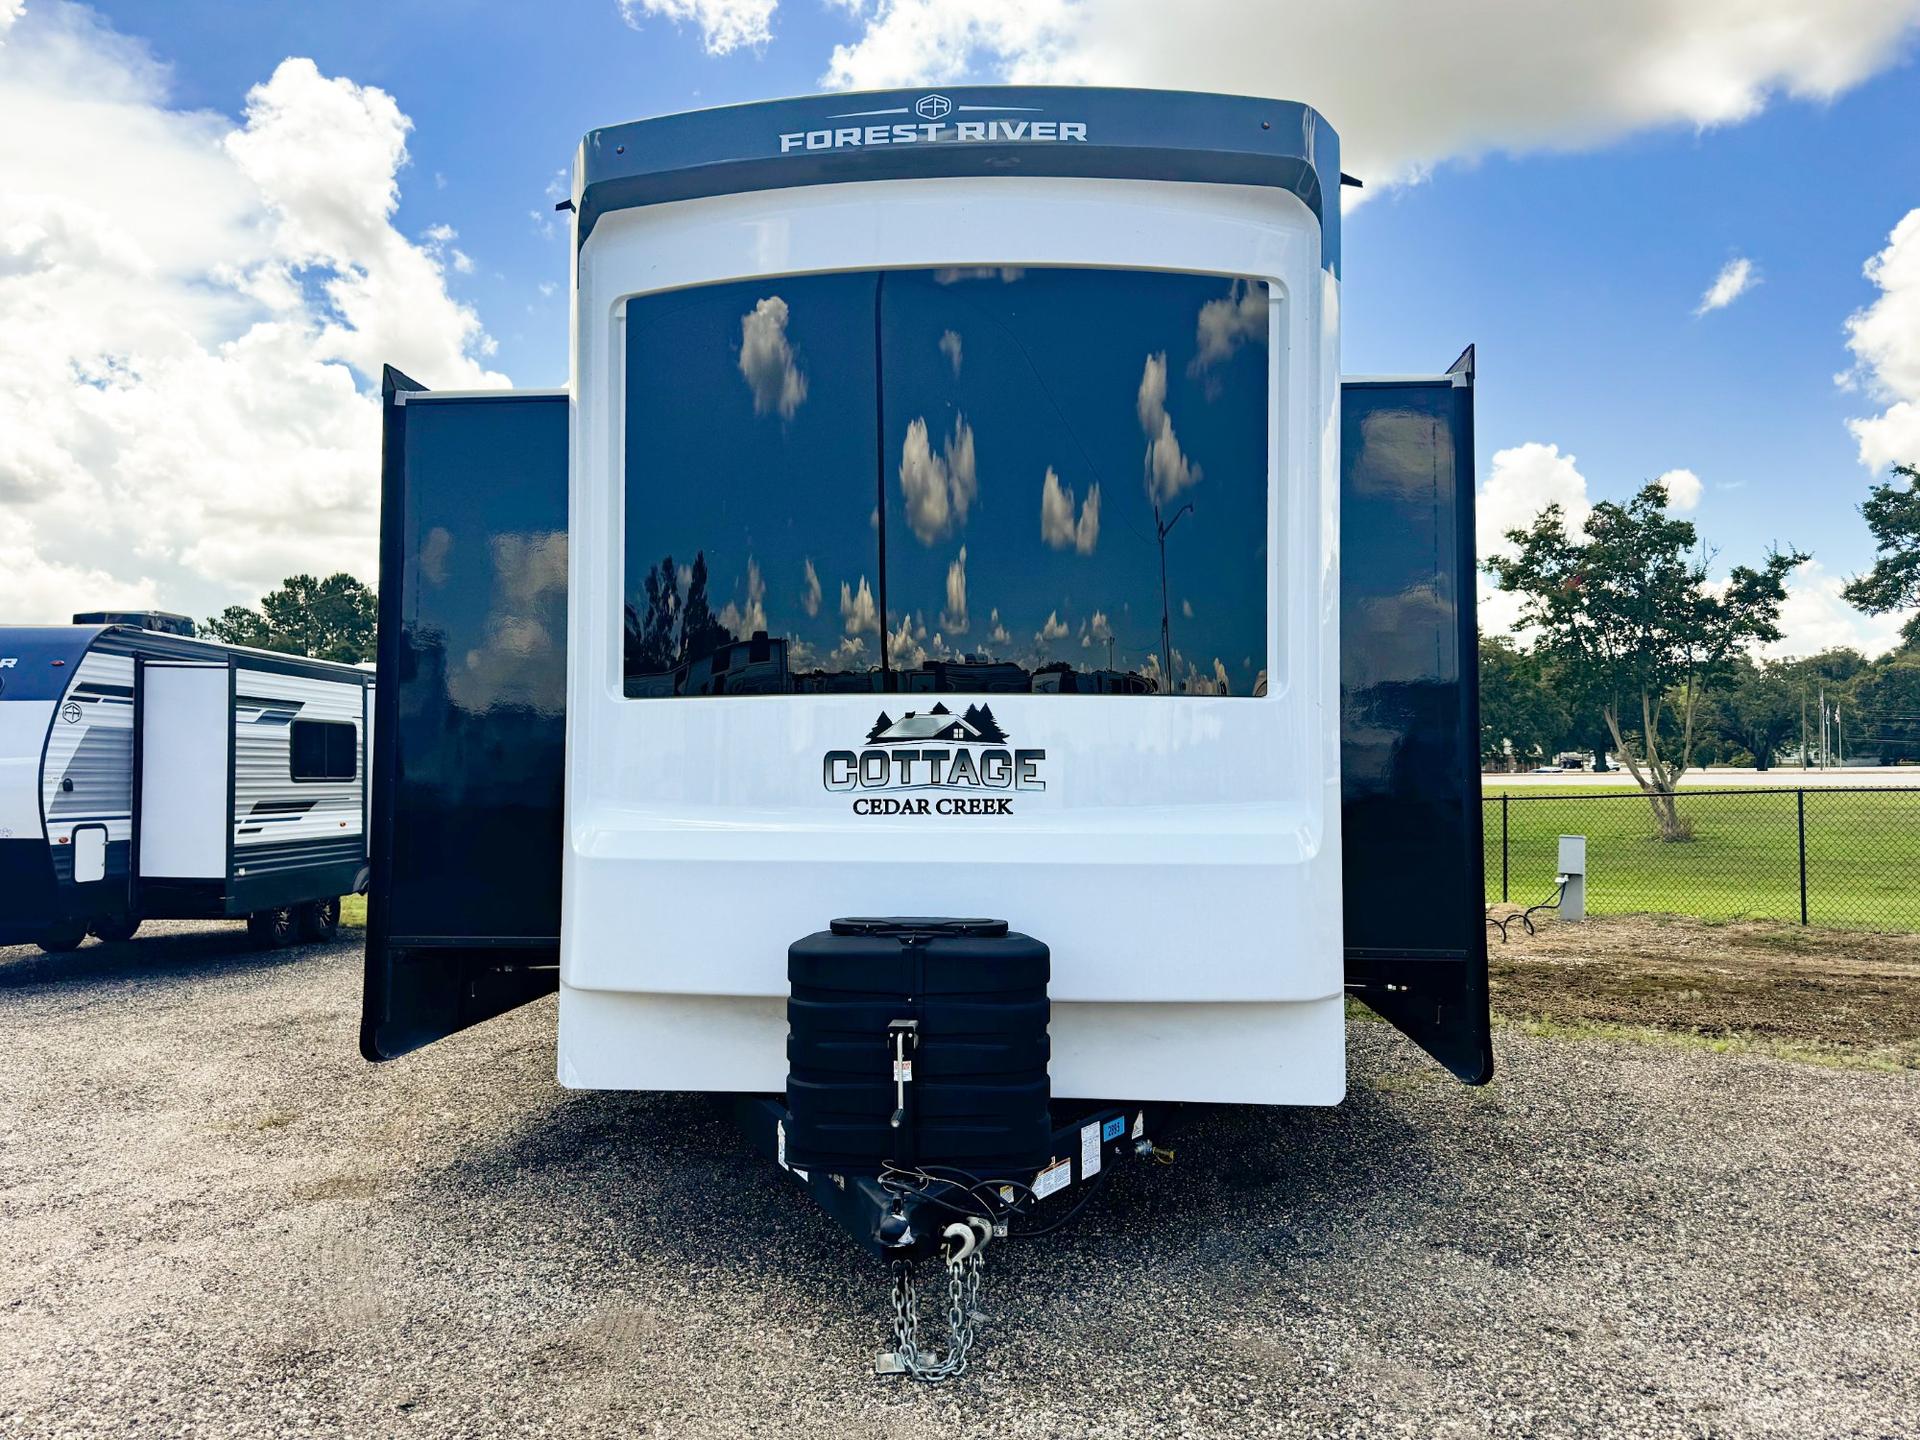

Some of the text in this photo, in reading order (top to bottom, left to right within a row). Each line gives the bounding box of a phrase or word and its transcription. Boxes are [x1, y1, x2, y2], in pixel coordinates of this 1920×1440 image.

[779, 121, 1088, 153] FOREST RIVER
[823, 748, 1046, 792] COTTAGE
[853, 798, 1014, 815] CEDAR CREEK
